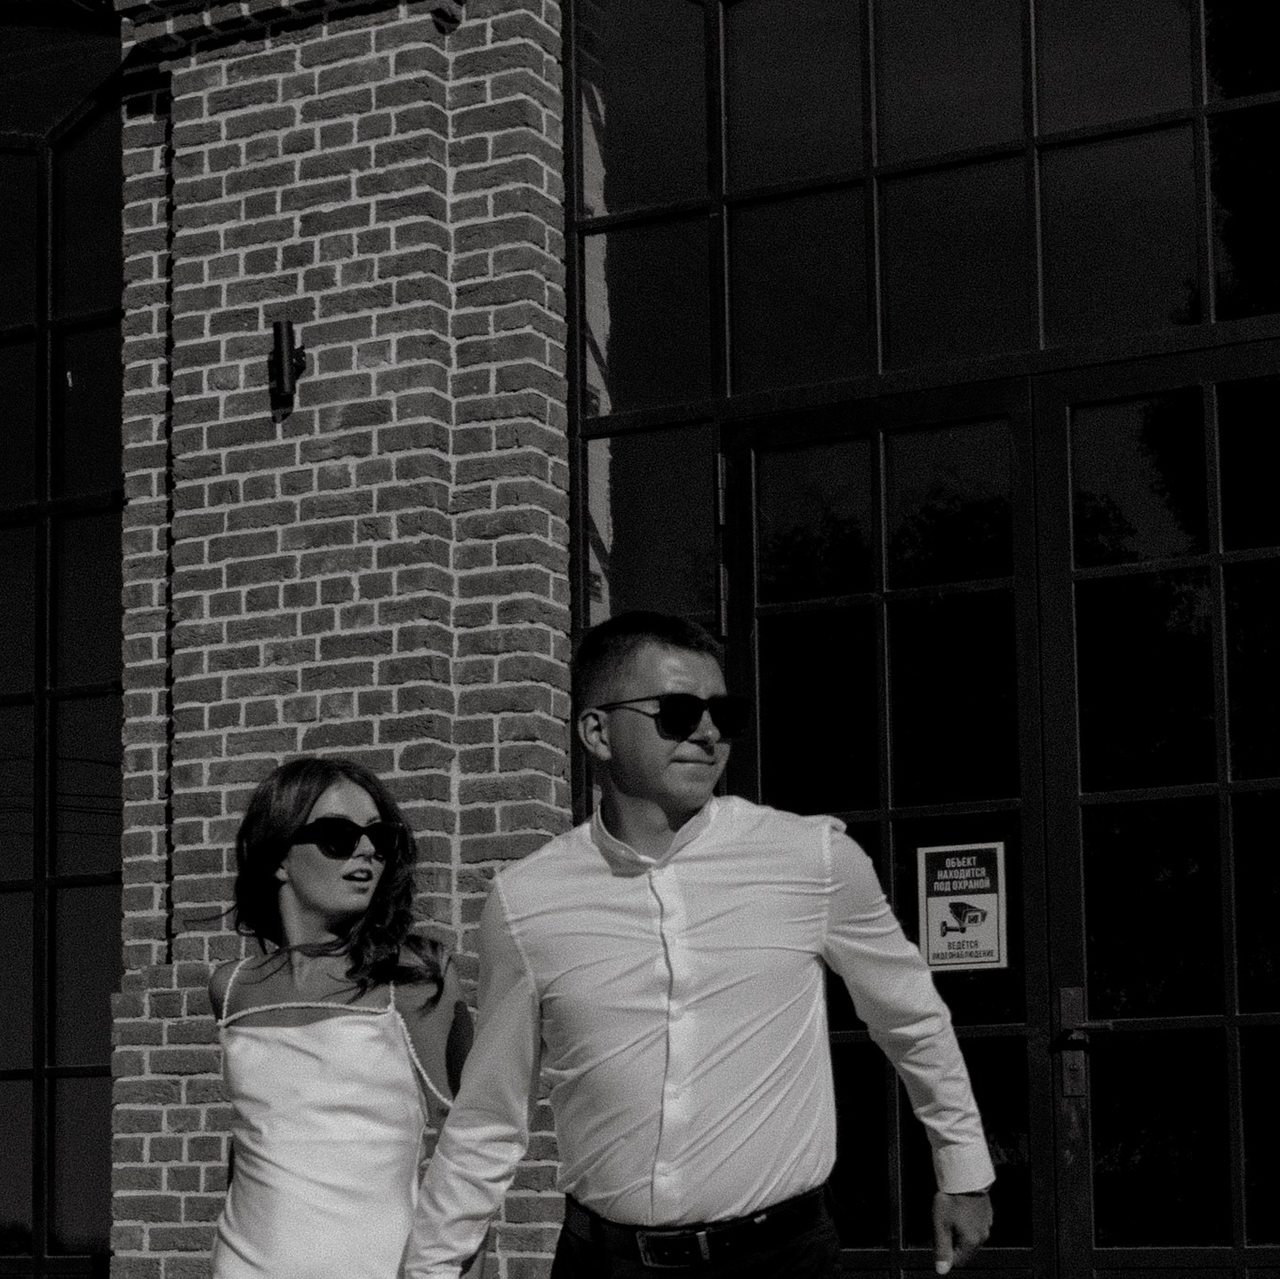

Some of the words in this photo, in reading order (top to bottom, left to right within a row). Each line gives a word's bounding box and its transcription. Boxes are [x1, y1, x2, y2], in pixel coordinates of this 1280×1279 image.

[945, 856, 977, 868] ОБЪЕКТ
[937, 867, 986, 880] НАХОДИТСЯ
[933, 881, 951, 892] ПОД
[952, 877, 990, 890] ОХРАНОЙ
